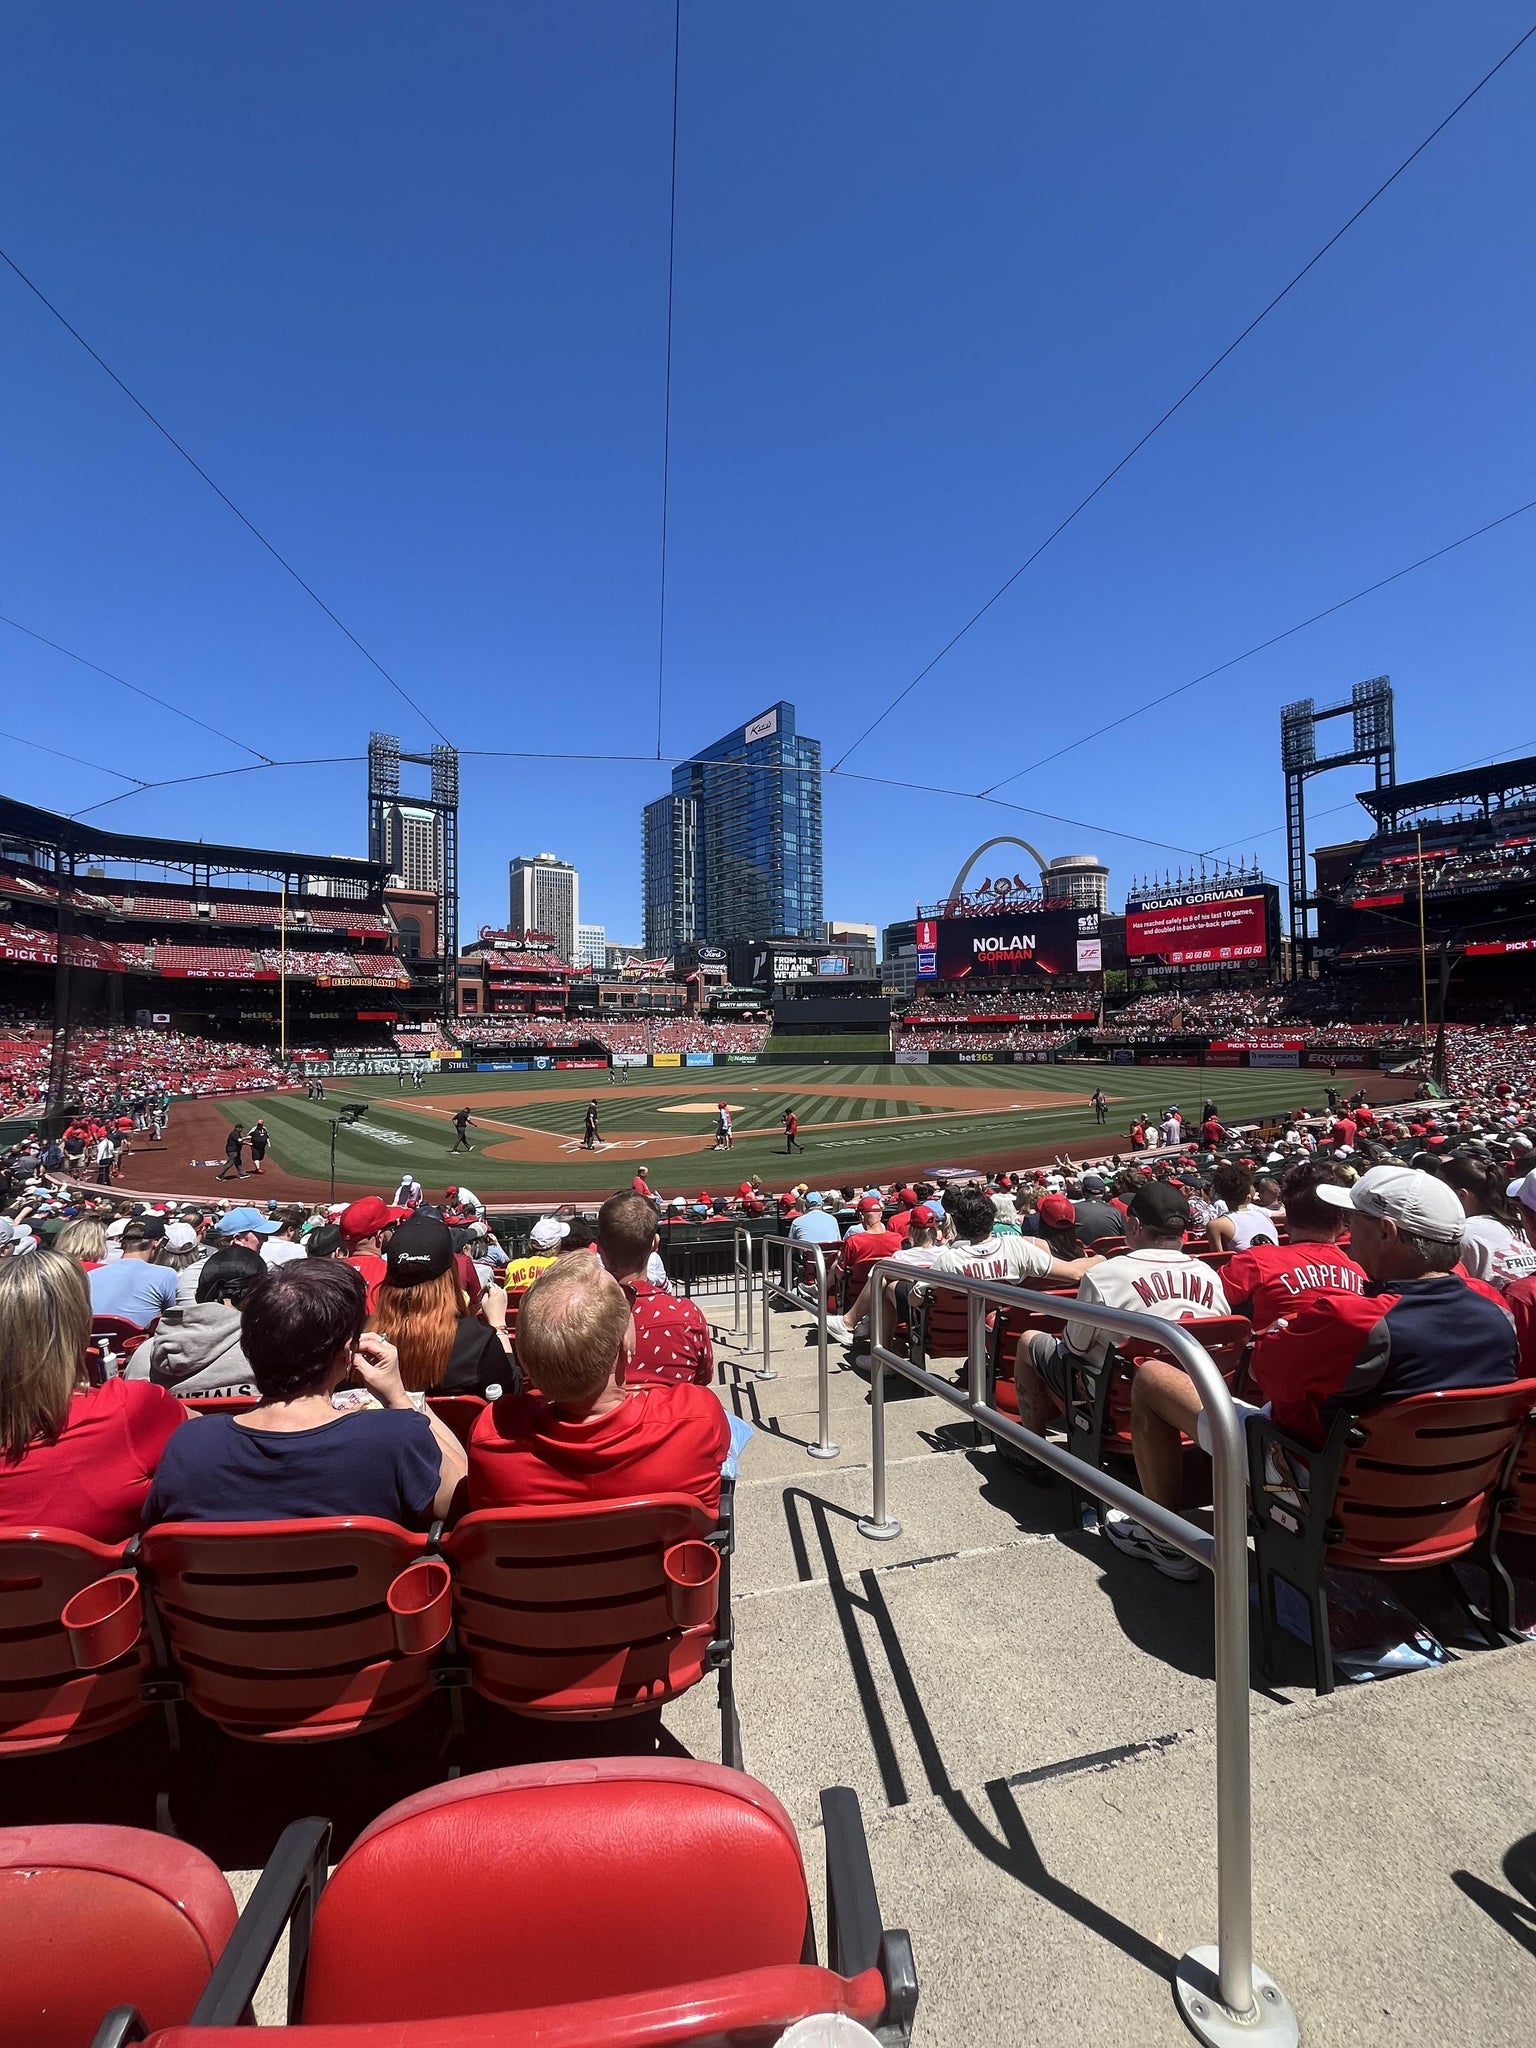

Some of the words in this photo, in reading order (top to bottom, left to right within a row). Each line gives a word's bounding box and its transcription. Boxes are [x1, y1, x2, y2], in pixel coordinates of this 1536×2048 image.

[1140, 888, 1177, 898] WORLD
[1180, 877, 1248, 891] CHAMPIONS
[1416, 889, 1452, 900] BNJAMIN
[1461, 885, 1499, 895] EDWARDS
[1142, 897, 1182, 910] NOLAN
[1186, 888, 1244, 904] GORMAN
[937, 897, 1075, 920] Budweiser
[1078, 914, 1098, 926] stl
[1144, 919, 1165, 928] reached
[1165, 917, 1182, 926] safely
[1211, 911, 1222, 919] last
[1223, 910, 1231, 918] 10
[1232, 908, 1255, 918] games,
[1154, 926, 1175, 935] doubled
[1183, 920, 1220, 931] back-to-back
[1221, 918, 1243, 928] games.
[973, 935, 1036, 952] NOLAN
[1234, 947, 1242, 955] GO
[1244, 946, 1252, 954] GO
[1253, 945, 1262, 954] GO
[1505, 941, 1528, 951] PICK
[6, 948, 36, 960] PICK
[43, 953, 57, 963] TO
[65, 957, 98, 969] CLICK
[704, 949, 722, 958] Ford
[978, 949, 1032, 962] GORMAN
[1194, 951, 1202, 959] GO
[1203, 950, 1211, 958] GO
[622, 969, 640, 977] BREW
[791, 964, 807, 972] AND
[1147, 965, 1179, 976] BROWN
[1190, 961, 1240, 972] CROUPPEN
[332, 977, 350, 986] BIG
[351, 978, 372, 986] MAC
[373, 979, 396, 987] LAND
[240, 1011, 273, 1019] bet365
[309, 1011, 339, 1019] bet365
[959, 1053, 993, 1062] bet365
[1308, 1053, 1365, 1063] EQUIFAX
[512, 1267, 527, 1284] MC
[962, 1259, 1008, 1279] MOLINA
[1280, 1264, 1364, 1295] CARPENTE
[1131, 1270, 1214, 1310] MOLINA
[1281, 1514, 1286, 1524] 8
